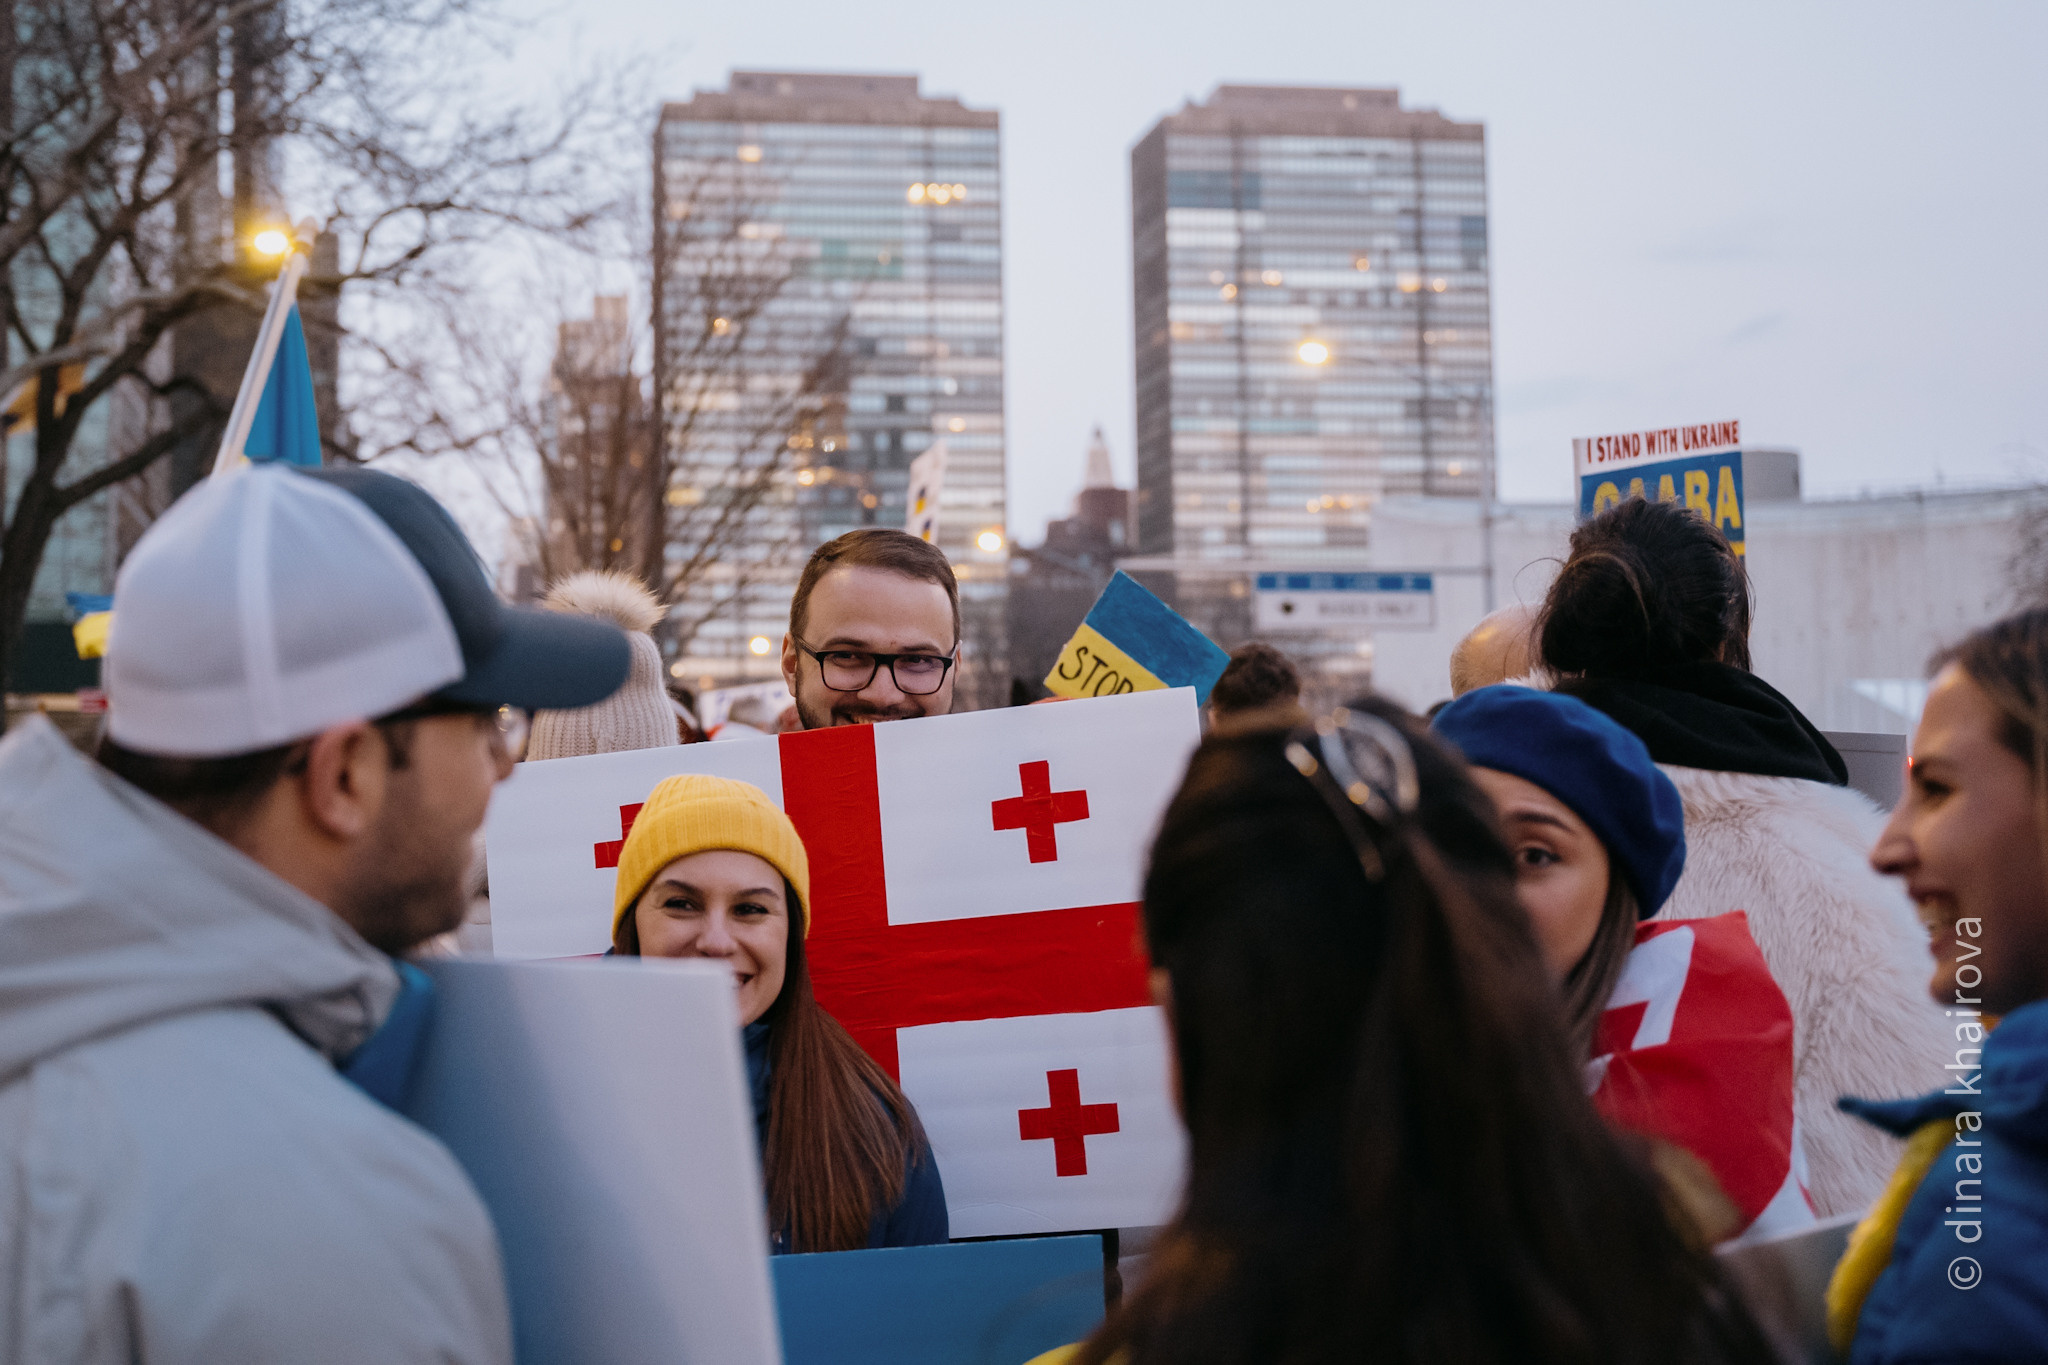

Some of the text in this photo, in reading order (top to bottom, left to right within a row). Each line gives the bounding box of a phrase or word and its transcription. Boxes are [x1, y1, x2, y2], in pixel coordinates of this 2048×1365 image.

[1587, 420, 1739, 463] I STAND WITH UKRAINE
